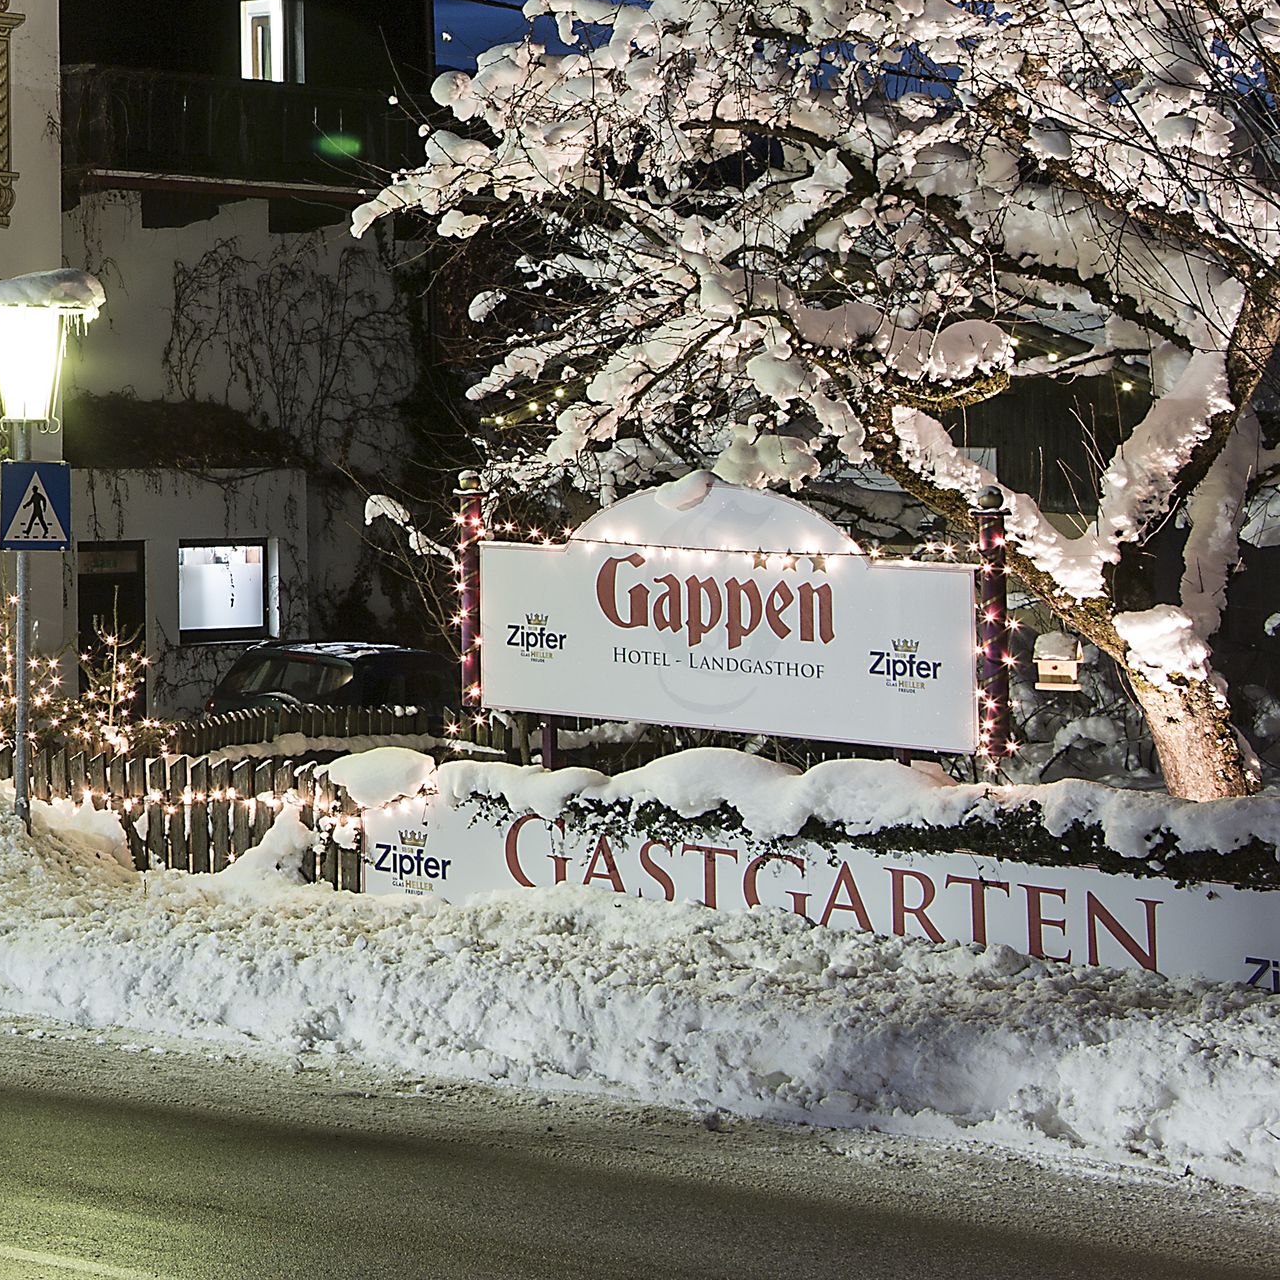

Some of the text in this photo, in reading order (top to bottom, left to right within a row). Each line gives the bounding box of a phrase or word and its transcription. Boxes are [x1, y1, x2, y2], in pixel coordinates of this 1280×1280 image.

[596, 553, 835, 650] Gappen
[507, 624, 567, 651] Zipfer
[613, 647, 670, 667] HOTEL
[689, 652, 825, 679] LANDGASTHOF
[869, 651, 942, 681] Zipfer
[374, 843, 451, 880] Zipfer
[405, 879, 434, 892] HELLER
[504, 813, 1164, 972] GASTGARTEN
